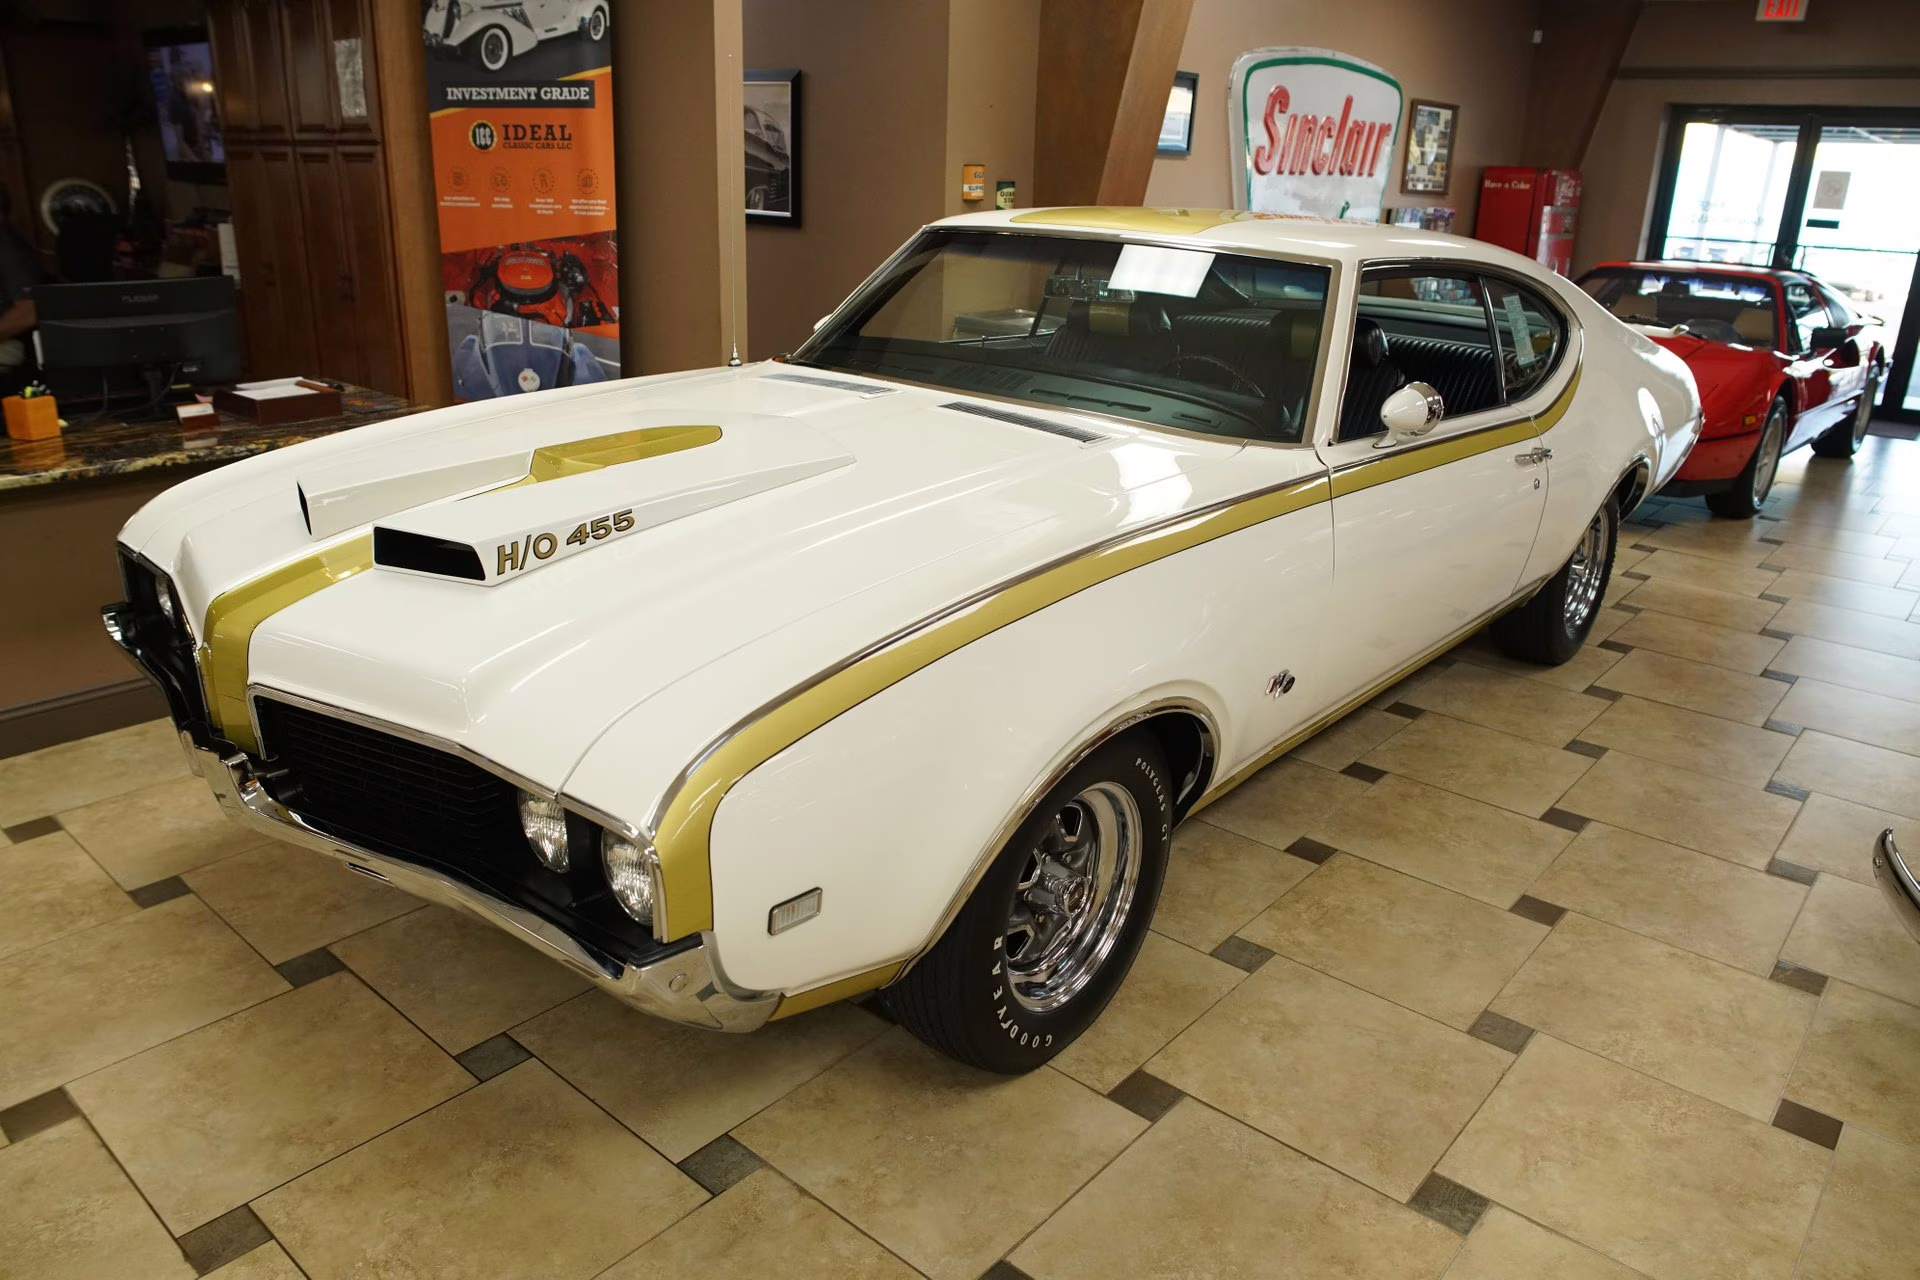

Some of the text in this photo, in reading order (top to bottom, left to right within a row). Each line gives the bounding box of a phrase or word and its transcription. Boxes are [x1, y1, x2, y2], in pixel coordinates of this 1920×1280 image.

[446, 87, 590, 100] INVESTMENT GRADE
[502, 124, 572, 141] IDEAL
[503, 142, 573, 150] CLASSIC CARS LLC
[1254, 85, 1393, 177] Sinclair
[497, 508, 636, 576] H/O 455
[1135, 757, 1168, 841] POLYGLAS GT
[992, 935, 1053, 1048] GOODYEAR
